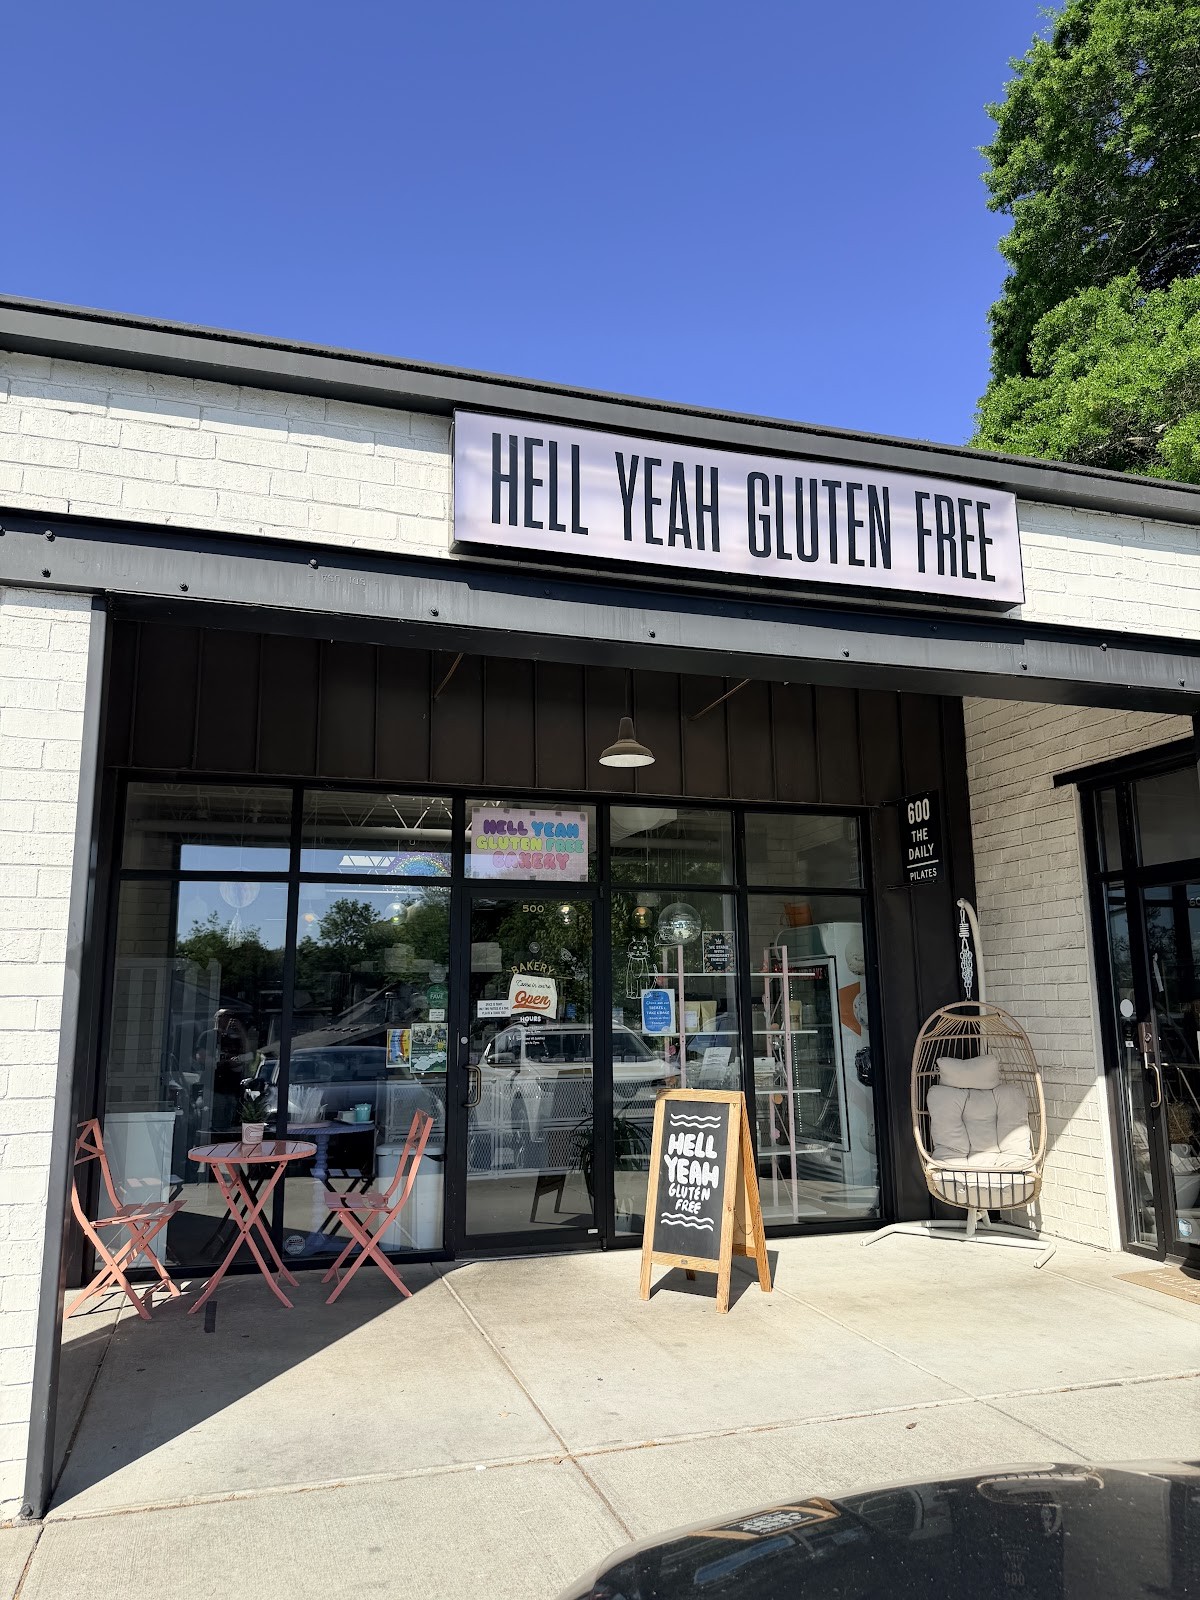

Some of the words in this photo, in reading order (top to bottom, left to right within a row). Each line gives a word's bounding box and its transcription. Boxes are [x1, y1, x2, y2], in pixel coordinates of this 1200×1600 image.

[491, 431, 589, 536] HELL
[614, 451, 721, 553] YEAH
[747, 471, 893, 570] GLUTEN
[914, 490, 997, 583] FREE
[907, 798, 930, 824] 600
[483, 819, 529, 836] HELL
[530, 820, 580, 839] YEAH
[911, 827, 929, 843] THE
[476, 834, 543, 852] GLUTEN
[545, 838, 585, 854] FREE
[908, 843, 935, 861] DAILY
[492, 850, 570, 871] BAKERY
[909, 867, 938, 881] PILATES
[522, 904, 545, 913] 500
[511, 960, 555, 975] BAKERY
[512, 991, 550, 1009] Open
[667, 1132, 718, 1159] HELL
[663, 1154, 720, 1189] YEAH
[668, 1182, 711, 1201] GLUTEN
[675, 1199, 702, 1215] FREE
